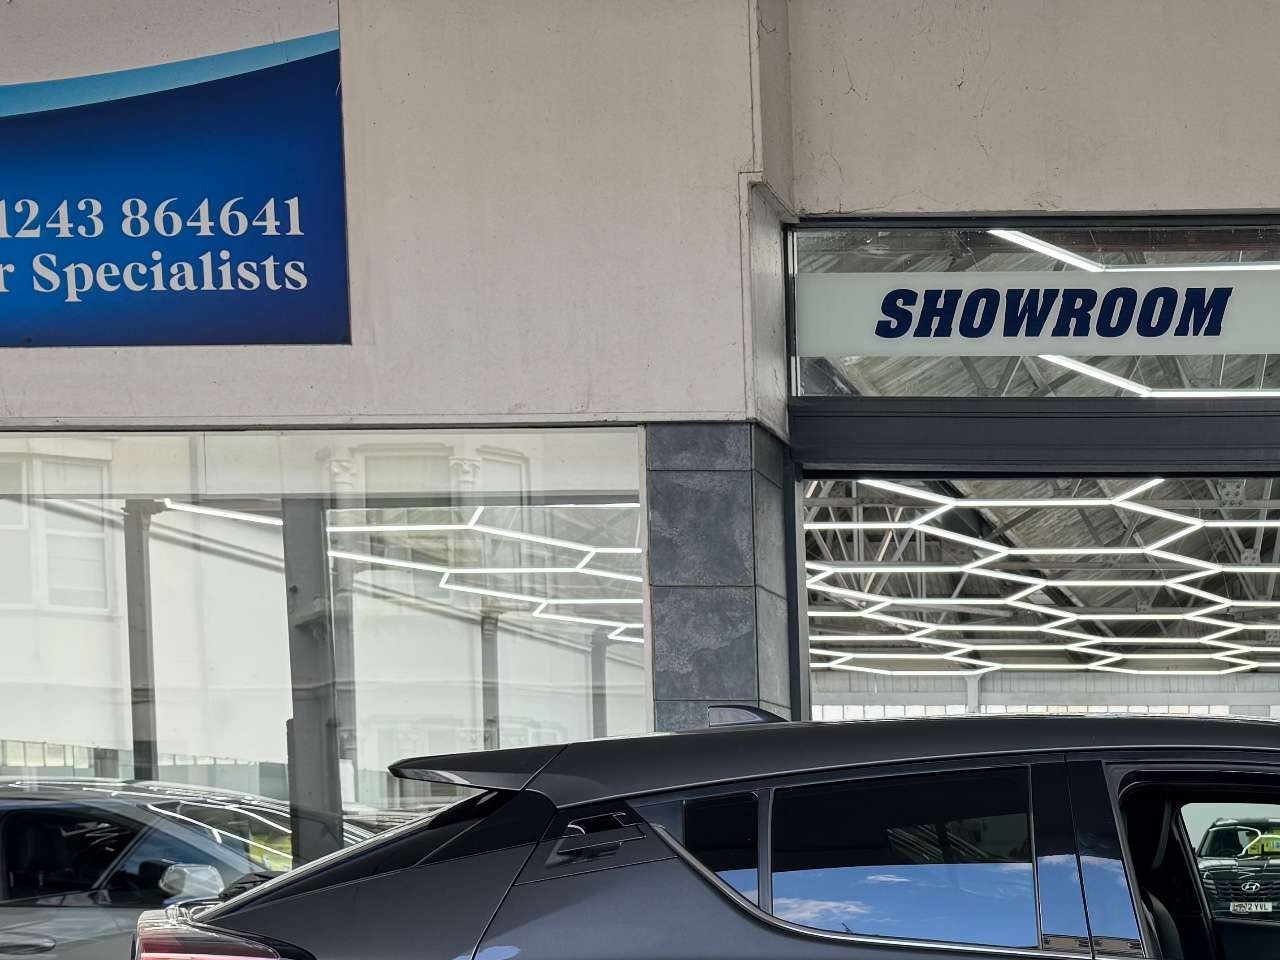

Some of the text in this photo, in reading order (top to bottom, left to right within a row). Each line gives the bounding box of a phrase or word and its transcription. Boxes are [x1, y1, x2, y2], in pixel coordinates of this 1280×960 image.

[0, 197, 305, 238] 1243 864641
[32, 250, 308, 303] Specialists
[874, 286, 1234, 339] SHOWROOM
